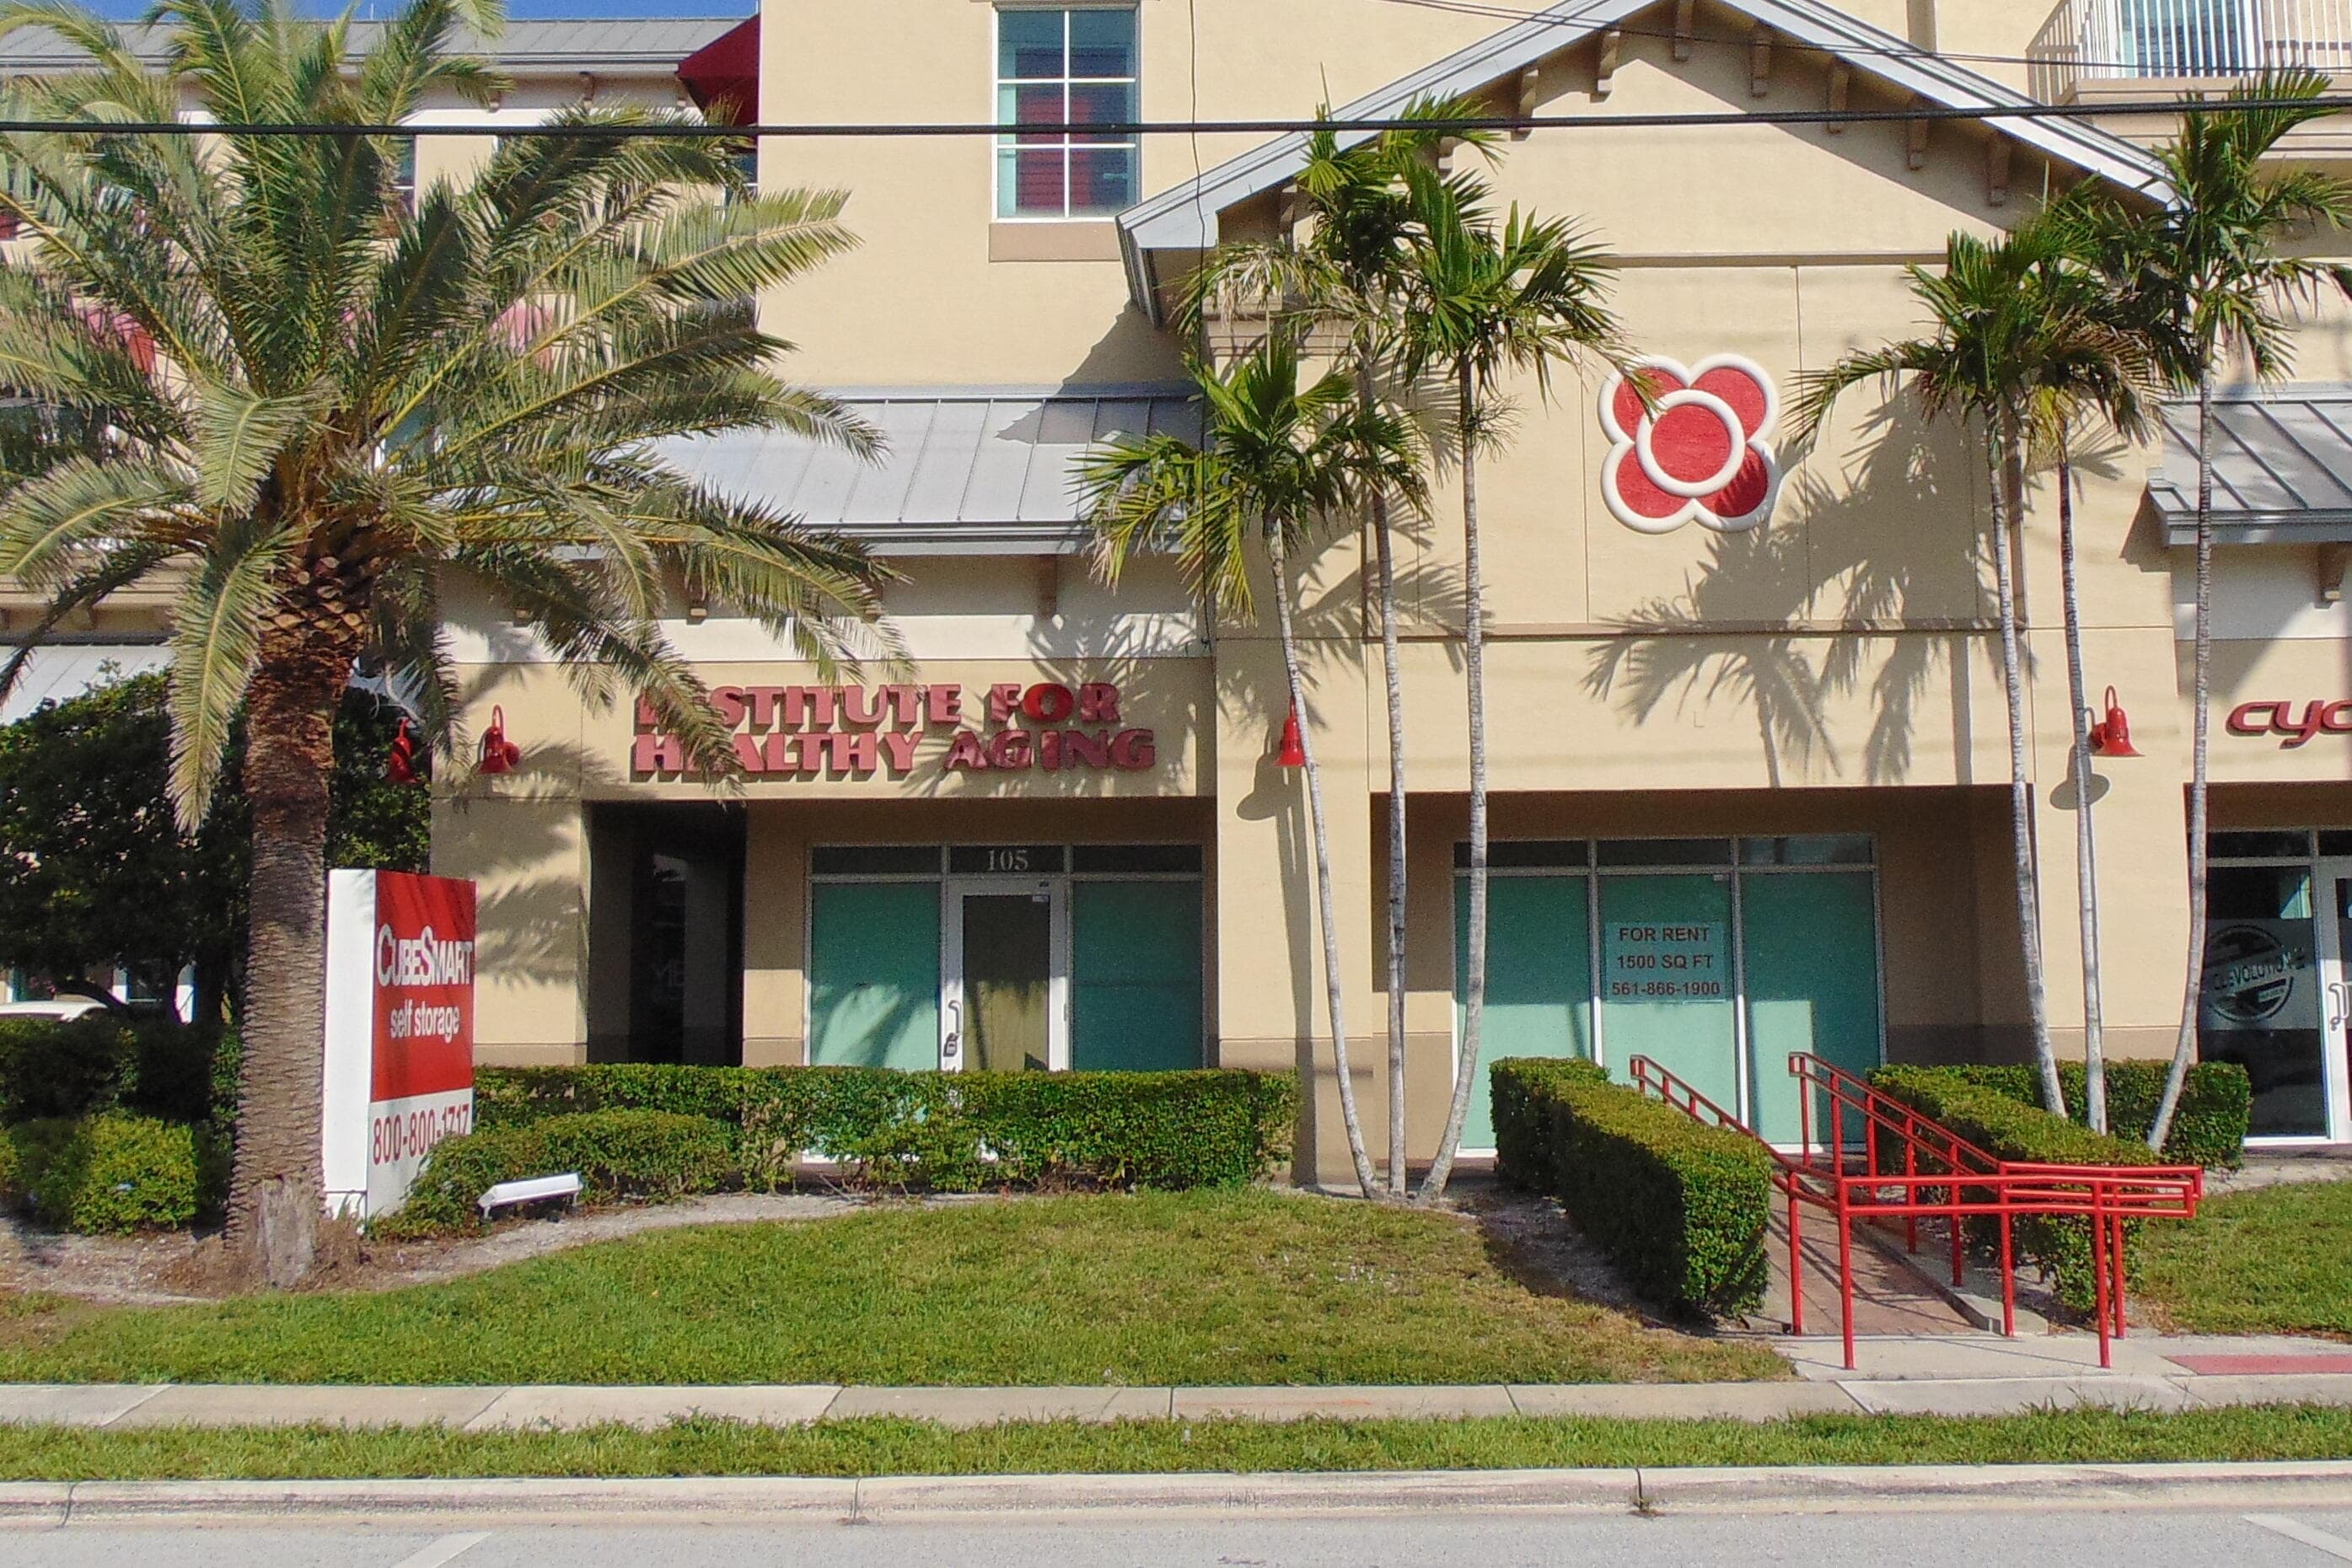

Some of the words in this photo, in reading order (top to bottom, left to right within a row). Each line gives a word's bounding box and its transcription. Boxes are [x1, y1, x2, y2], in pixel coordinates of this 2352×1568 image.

[638, 684, 961, 726] ISTITUTE
[991, 683, 1121, 722] FOR
[635, 731, 924, 772] HALTHY
[943, 728, 1156, 771] AGING
[988, 850, 1028, 871] 105
[1619, 927, 1657, 942] FOR
[1662, 927, 1710, 942] RENT
[1617, 954, 1656, 969] 1500
[1661, 954, 1688, 969] SQ
[1693, 953, 1714, 969] FT
[1612, 981, 1721, 996] 561-866-1900
[390, 999, 413, 1038] self
[414, 1001, 459, 1044] storage
[373, 1103, 470, 1166] 800-800-1717
